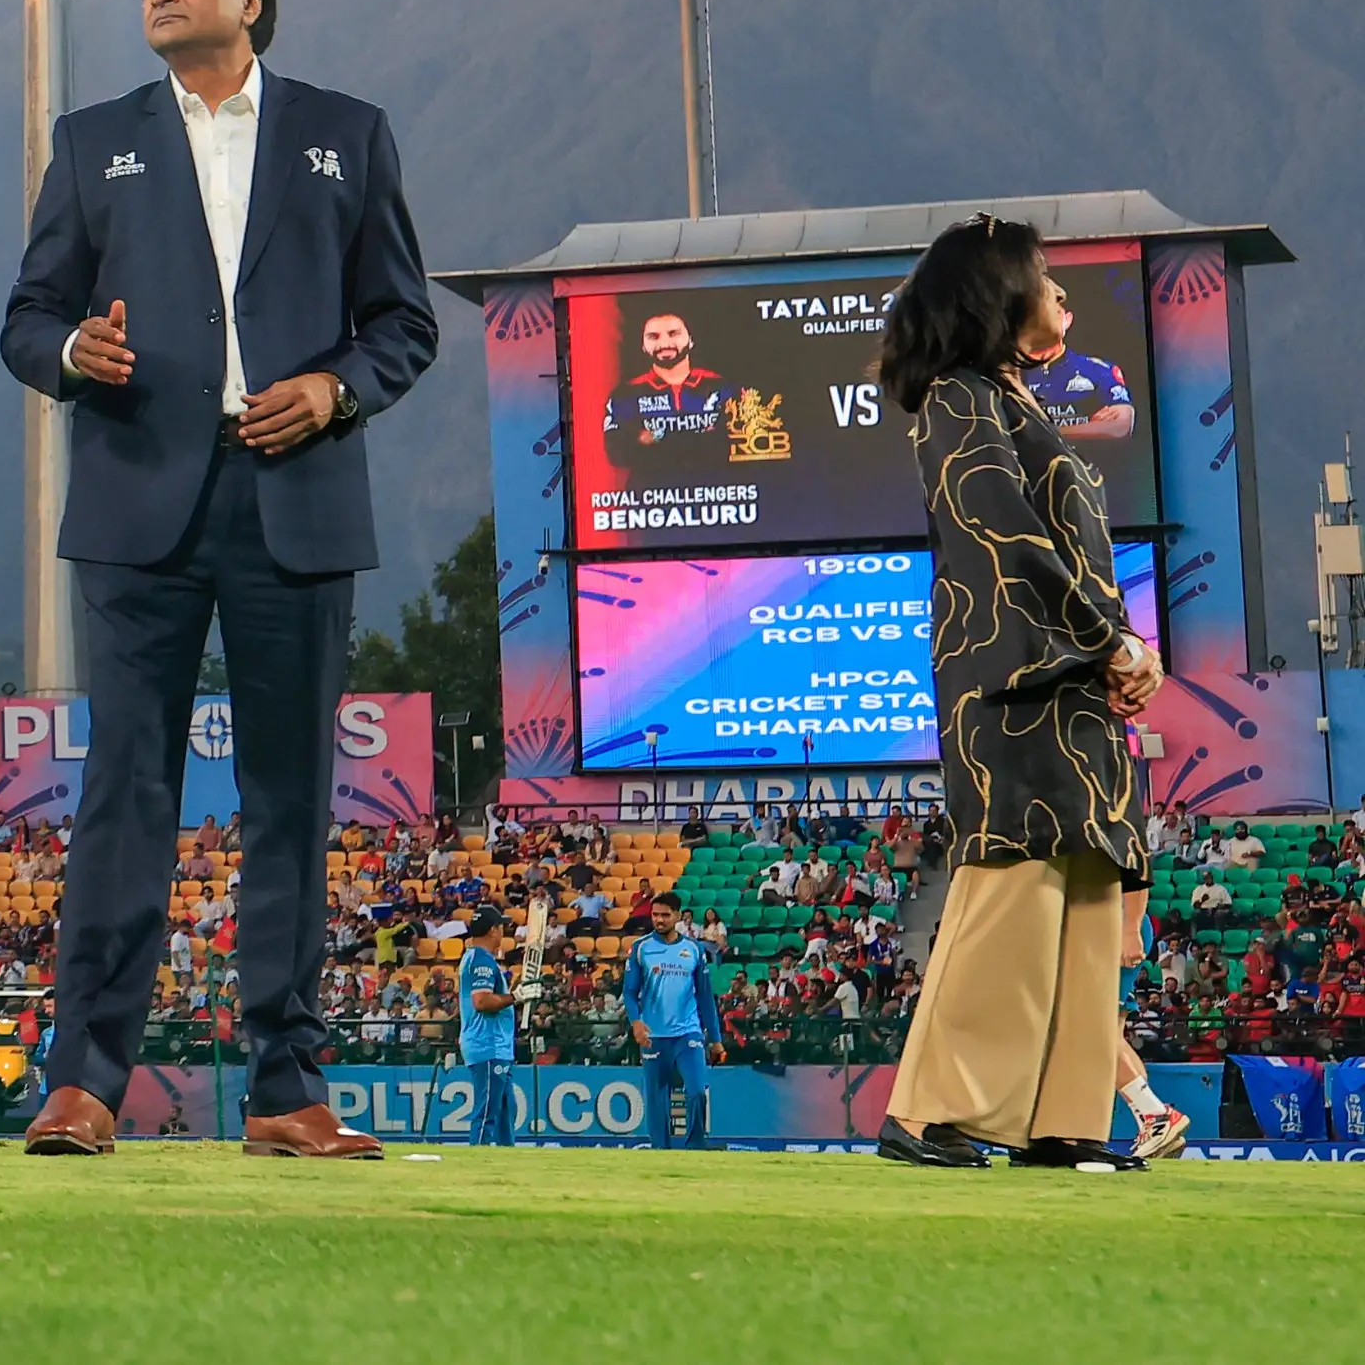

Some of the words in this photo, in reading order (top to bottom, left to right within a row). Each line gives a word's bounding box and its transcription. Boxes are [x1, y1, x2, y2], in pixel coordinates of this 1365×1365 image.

[322, 162, 345, 181] IPL
[756, 298, 827, 320] TATA
[832, 294, 876, 316] IPL
[803, 319, 886, 335] QUALIFIER
[829, 384, 881, 428] VS
[728, 431, 792, 455] RCB
[591, 491, 640, 508] ROYAL
[643, 484, 758, 505] CHALLENGERS
[593, 503, 758, 531] BENGALURU
[803, 555, 912, 576] 19:00
[749, 600, 932, 625] QUALIFIE
[763, 626, 840, 644] RCB
[850, 624, 903, 642] VS
[810, 670, 919, 688] HPCA
[685, 694, 849, 715] CRICKET
[715, 715, 938, 737] DHARAMSH
[328, 1080, 647, 1133] PLT2.CO
